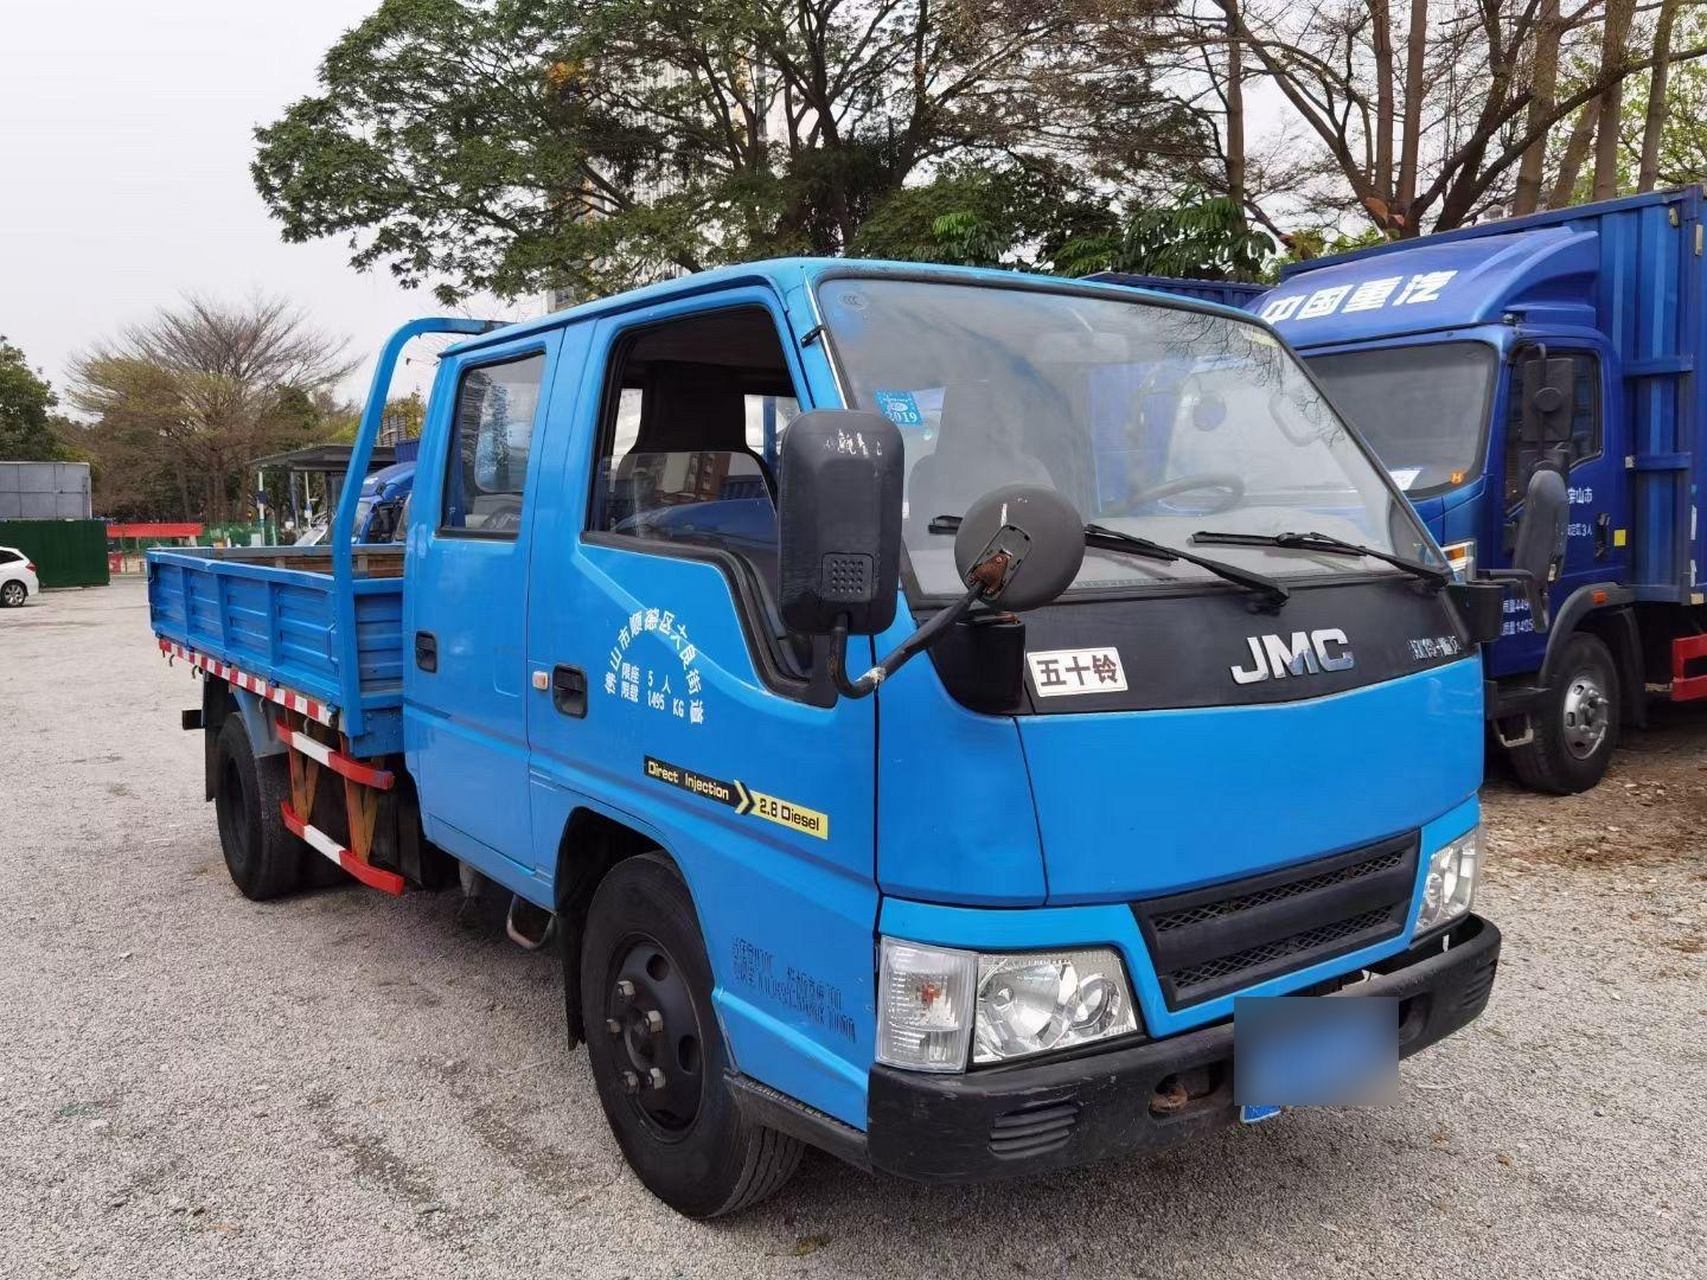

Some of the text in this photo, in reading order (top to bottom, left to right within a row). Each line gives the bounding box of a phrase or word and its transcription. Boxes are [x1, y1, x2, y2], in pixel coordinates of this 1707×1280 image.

[1260, 270, 1459, 325] 中国重汽
[1036, 654, 1118, 686] 五十铃
[1230, 628, 1355, 685] JMC
[647, 670, 654, 687] 5
[662, 674, 672, 694] 人
[673, 697, 685, 718] KG
[648, 760, 820, 832] Direct Injection 2.8 Diesel
